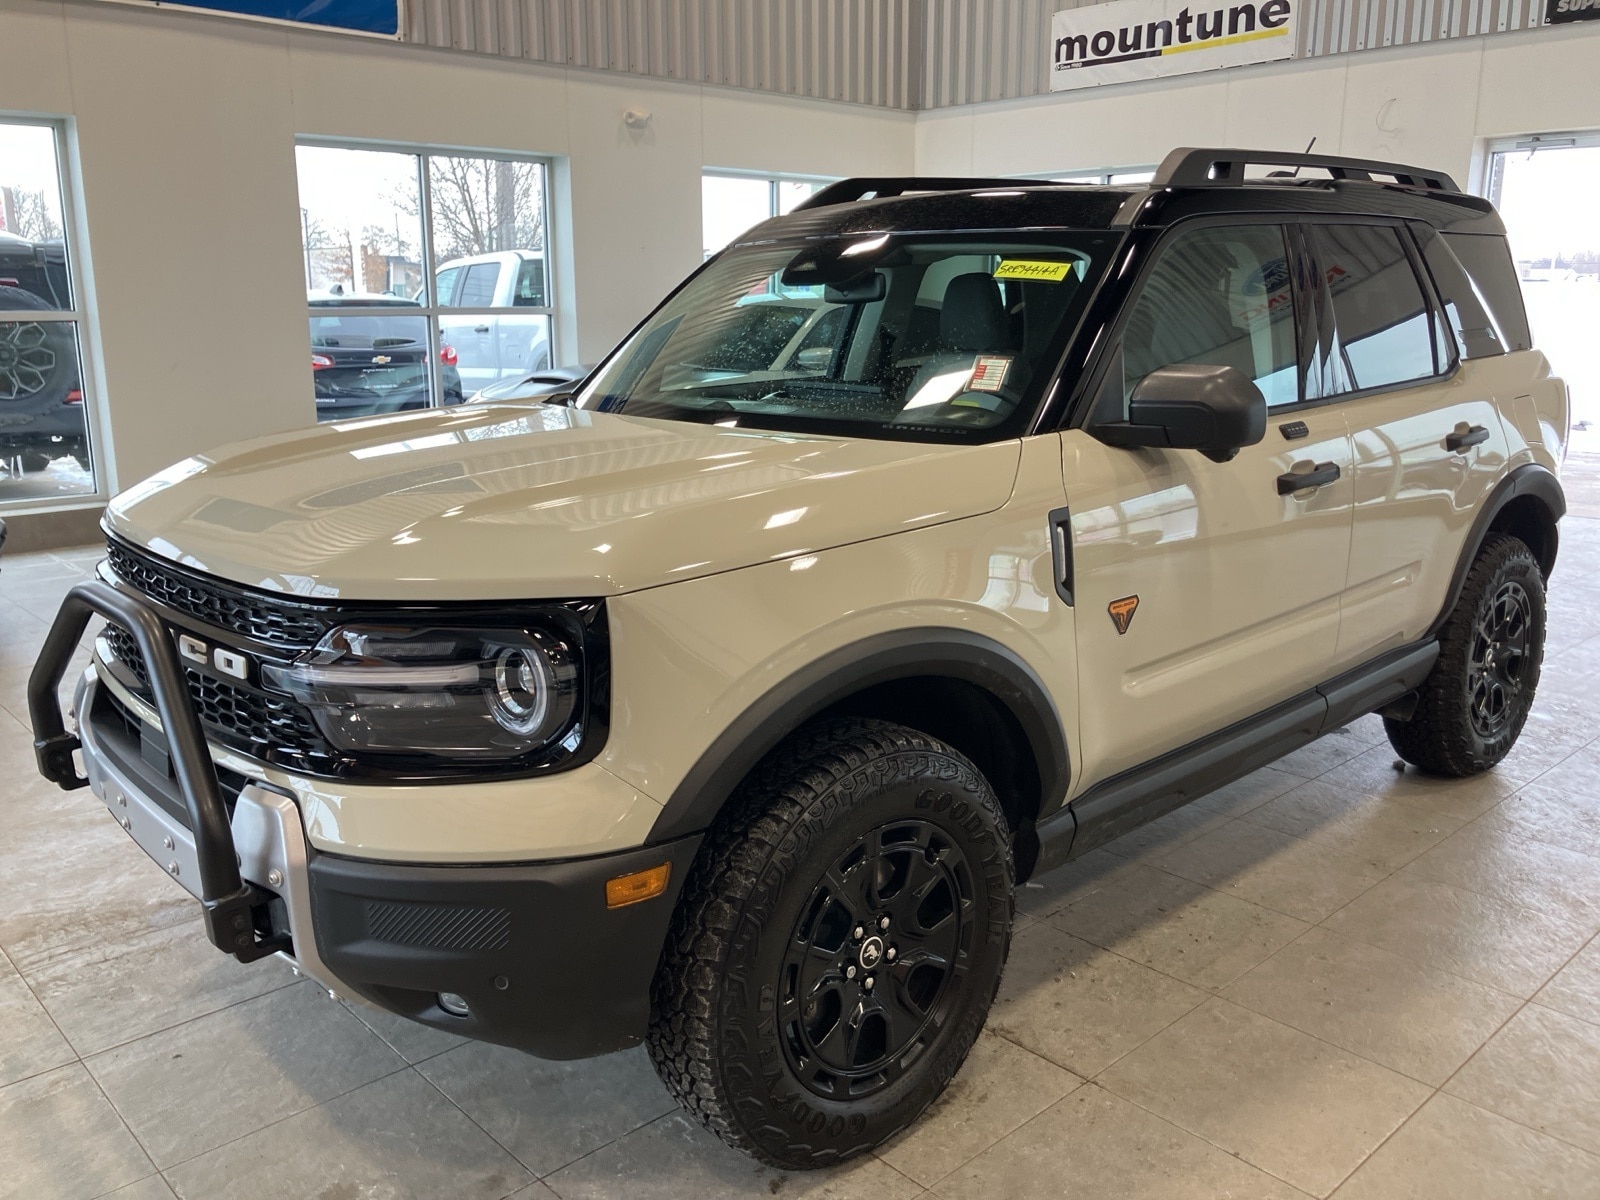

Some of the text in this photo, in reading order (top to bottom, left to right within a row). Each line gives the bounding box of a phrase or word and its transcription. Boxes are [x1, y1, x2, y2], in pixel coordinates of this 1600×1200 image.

[1056, 0, 1291, 63] mountune
[915, 787, 1005, 945] GOODYEAR
[757, 984, 866, 1138] GOODYEAR
